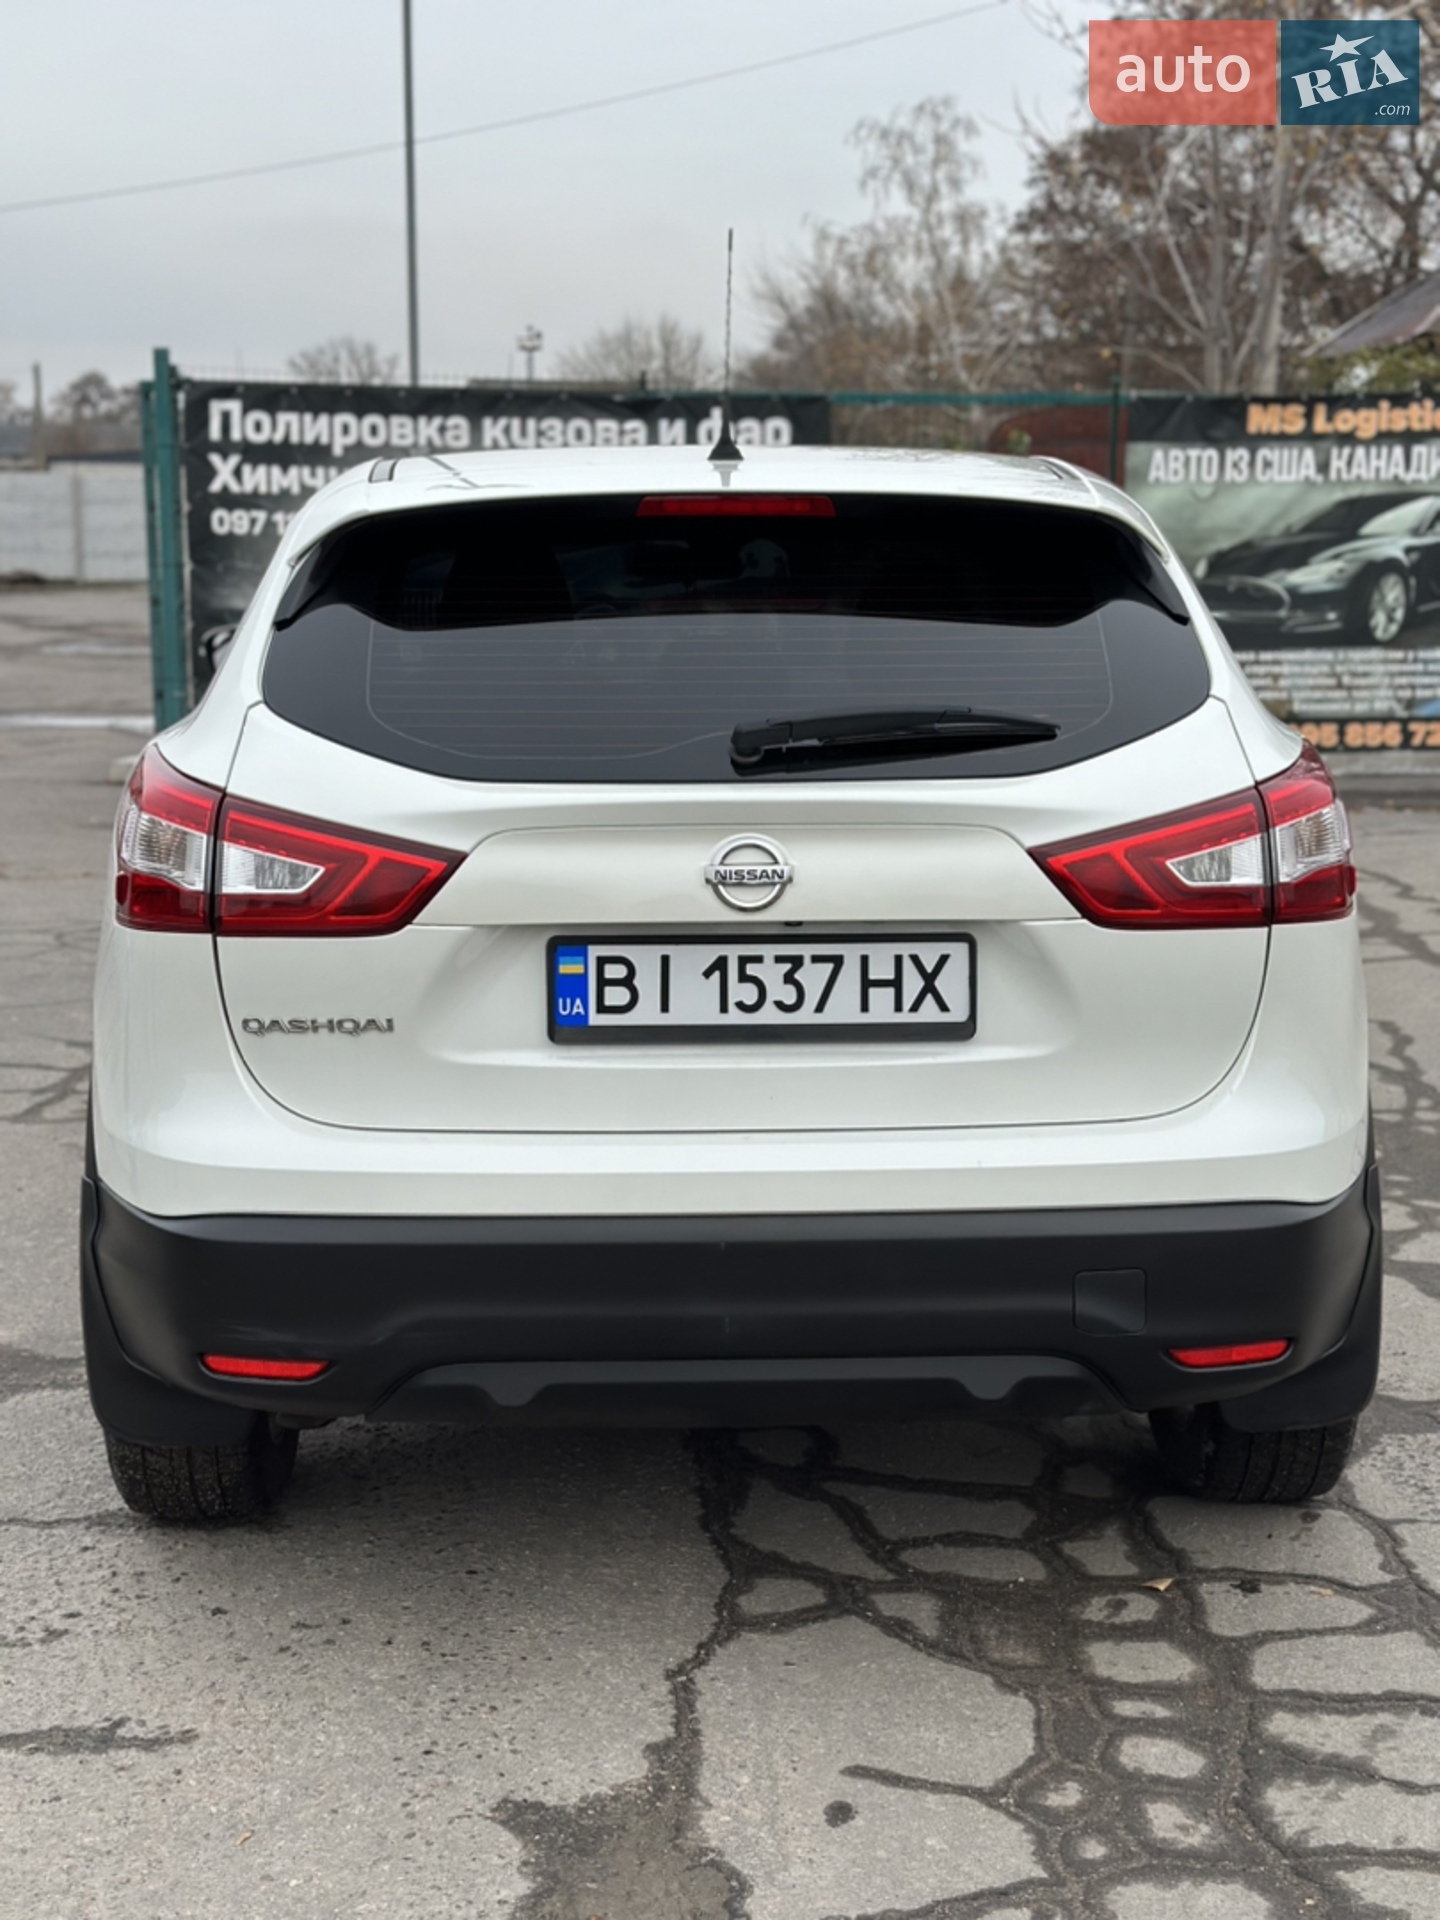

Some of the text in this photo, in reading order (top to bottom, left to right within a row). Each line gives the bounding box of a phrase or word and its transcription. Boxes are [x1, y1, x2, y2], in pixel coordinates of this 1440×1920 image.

[208, 398, 471, 457] Полировка
[481, 415, 649, 448] кузова
[658, 416, 686, 446] и
[1247, 402, 1306, 435] MS
[1148, 447, 1220, 484] АВТО
[1224, 446, 1251, 484] ІЗ
[1255, 446, 1323, 485] США,
[210, 507, 268, 536] 097
[714, 869, 785, 881] NISSAN
[595, 953, 951, 1015] BI 1537 HX
[558, 997, 585, 1016] UA
[241, 1017, 395, 1037] QASHQAI
